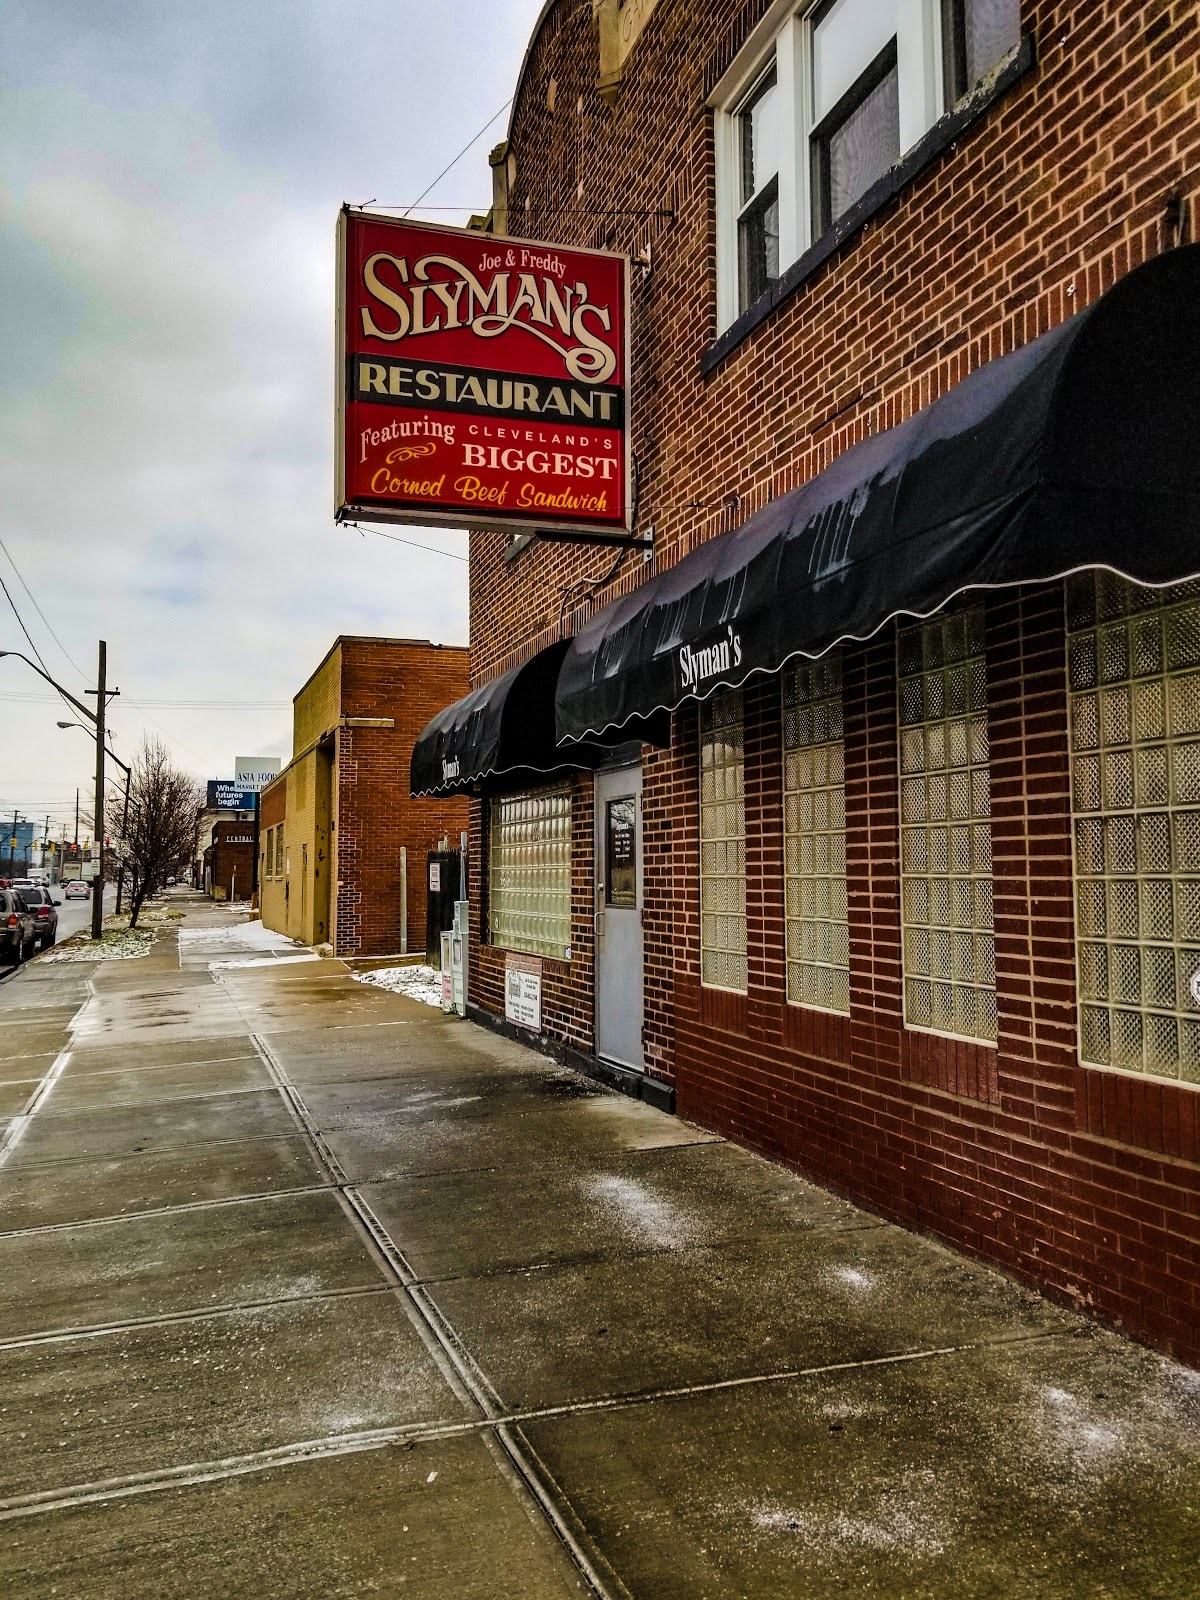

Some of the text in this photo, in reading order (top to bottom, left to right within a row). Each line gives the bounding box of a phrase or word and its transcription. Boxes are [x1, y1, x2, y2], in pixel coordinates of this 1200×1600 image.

[479, 249, 567, 277] Joe & Freddy
[361, 252, 617, 384] SLYMAN'S
[359, 362, 617, 421] RESTAURANT
[359, 415, 613, 464] Featuring CLEVELAND'S
[462, 443, 618, 480] BIGGEST
[370, 467, 607, 513] Corned Beef Sandwich
[680, 625, 741, 694] Slyman's
[238, 772, 255, 782] ASIA
